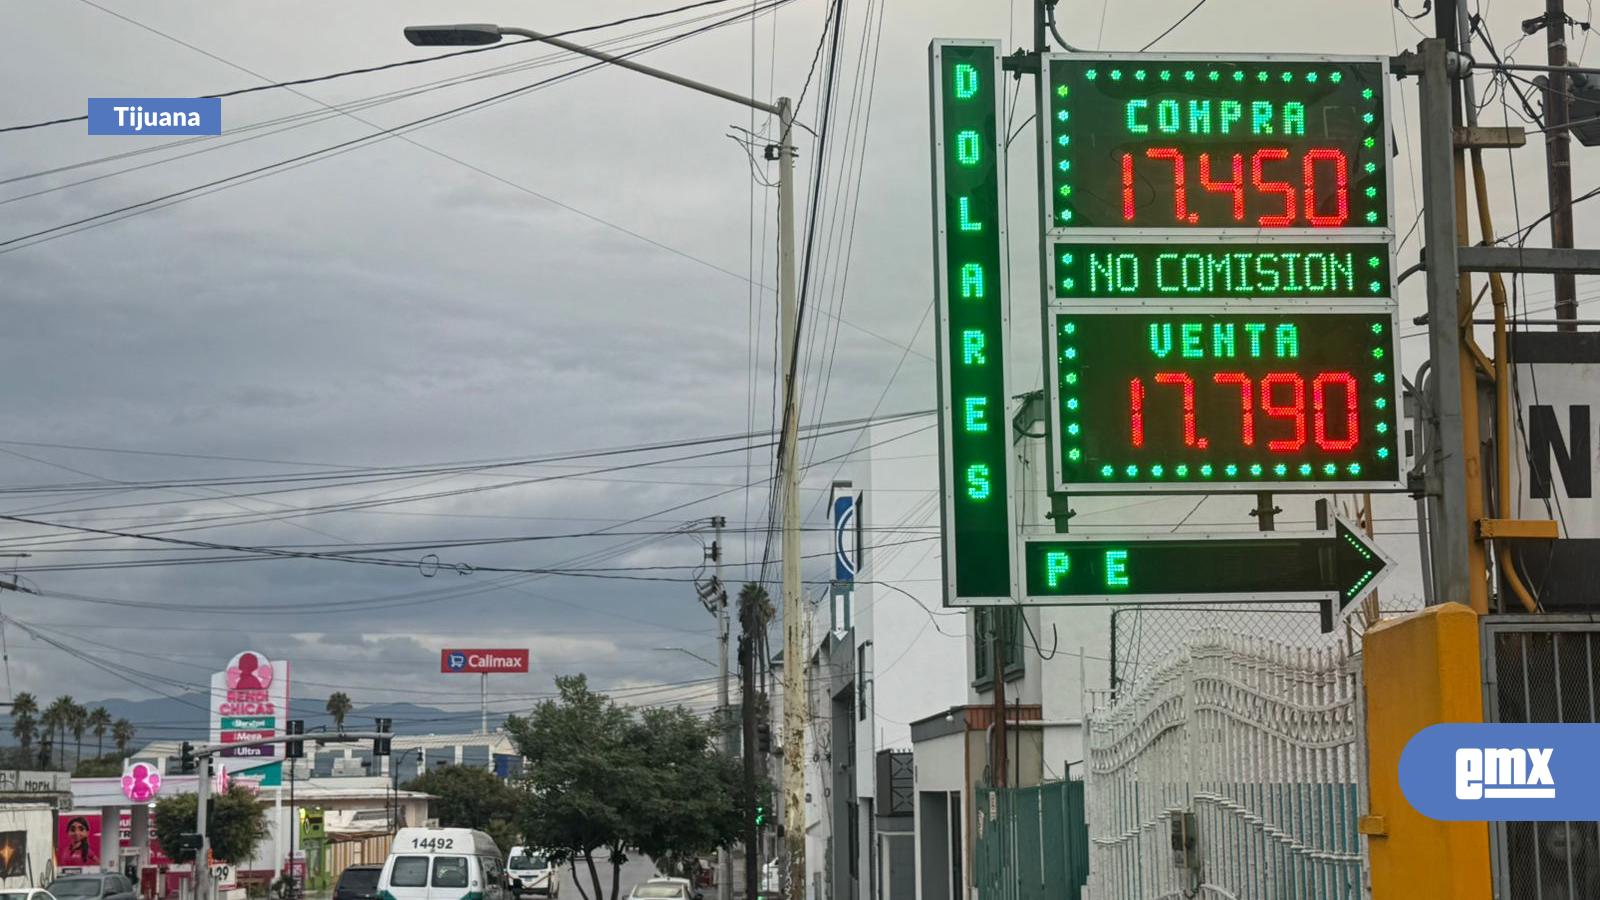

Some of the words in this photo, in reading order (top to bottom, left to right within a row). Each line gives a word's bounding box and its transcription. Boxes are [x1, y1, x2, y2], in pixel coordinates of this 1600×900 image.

[1126, 98, 1306, 137] COMPRA
[1121, 147, 1350, 229] 17.450
[954, 63, 992, 502] DOLARES
[1089, 252, 1140, 292] NO
[1155, 252, 1355, 293] COMISION
[1149, 322, 1300, 359] VENTA
[1129, 371, 1360, 453] 17.790
[468, 654, 522, 668] Calimax
[219, 703, 275, 716] CHICAS
[412, 838, 454, 849] 14492
